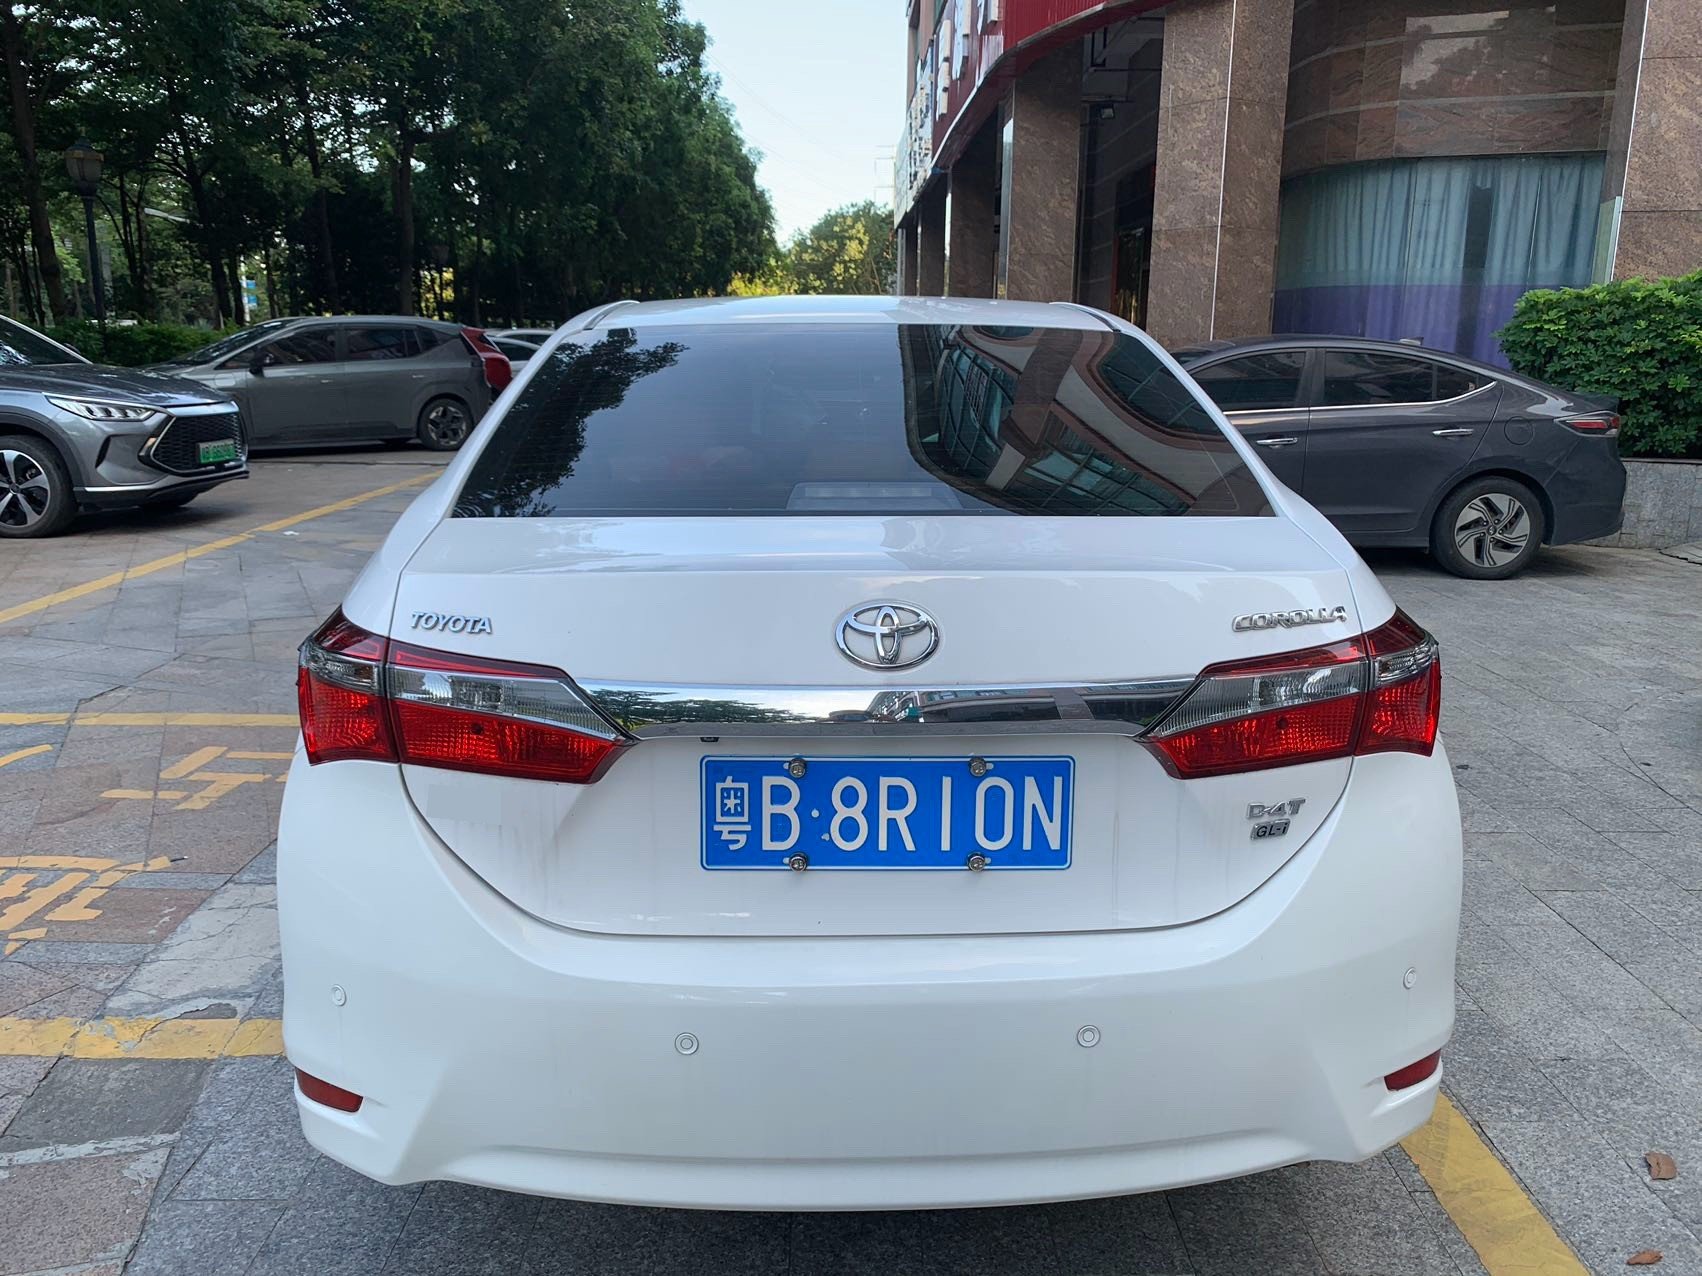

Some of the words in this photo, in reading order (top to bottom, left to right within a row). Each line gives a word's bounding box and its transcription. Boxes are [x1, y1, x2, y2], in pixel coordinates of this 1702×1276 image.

[411, 611, 493, 634] TOYOTA
[1232, 606, 1347, 632] COROLLA
[1246, 798, 1306, 819] D-4T
